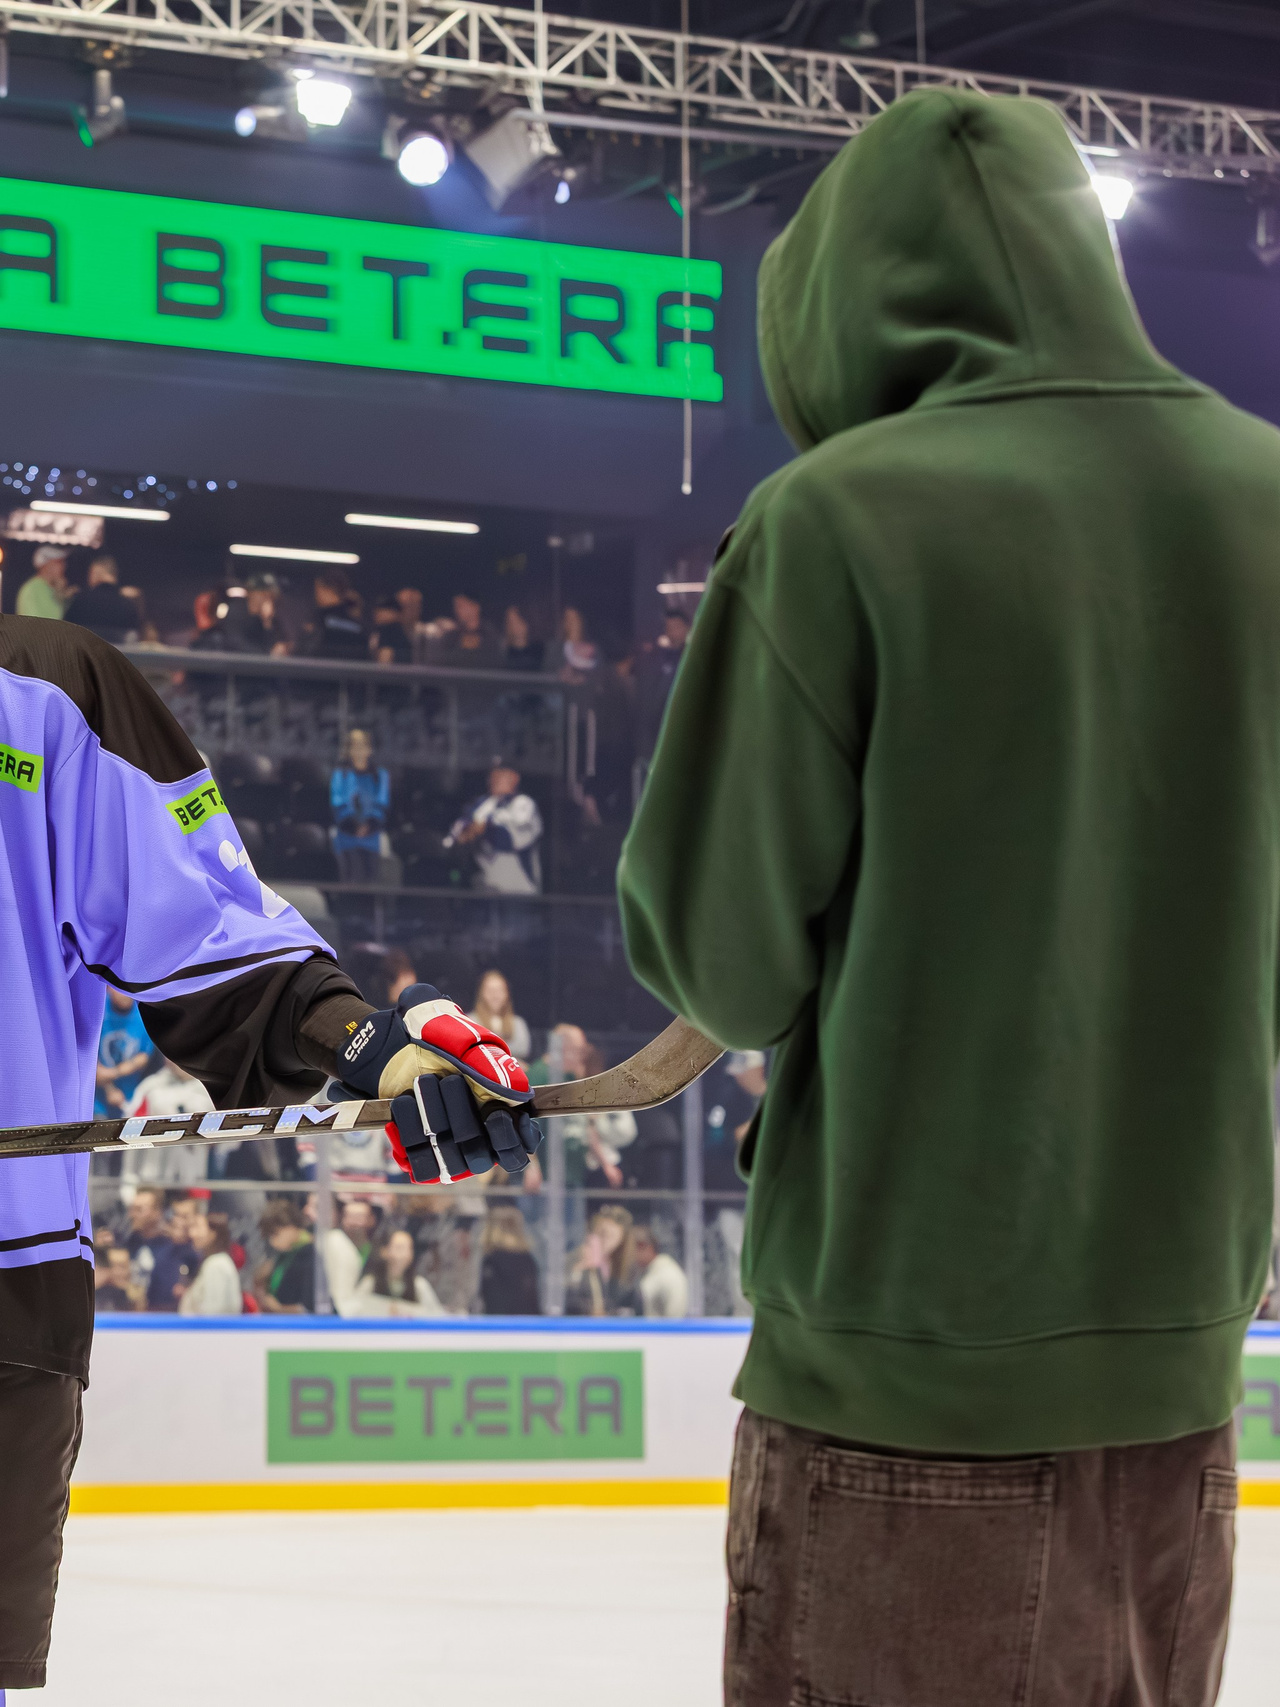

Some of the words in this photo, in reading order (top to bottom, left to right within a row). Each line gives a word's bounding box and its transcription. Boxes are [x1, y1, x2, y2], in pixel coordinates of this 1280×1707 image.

[344, 1021, 374, 1062] CCM
[120, 1100, 367, 1144] CCM
[290, 1377, 623, 1437] BET.ERA
